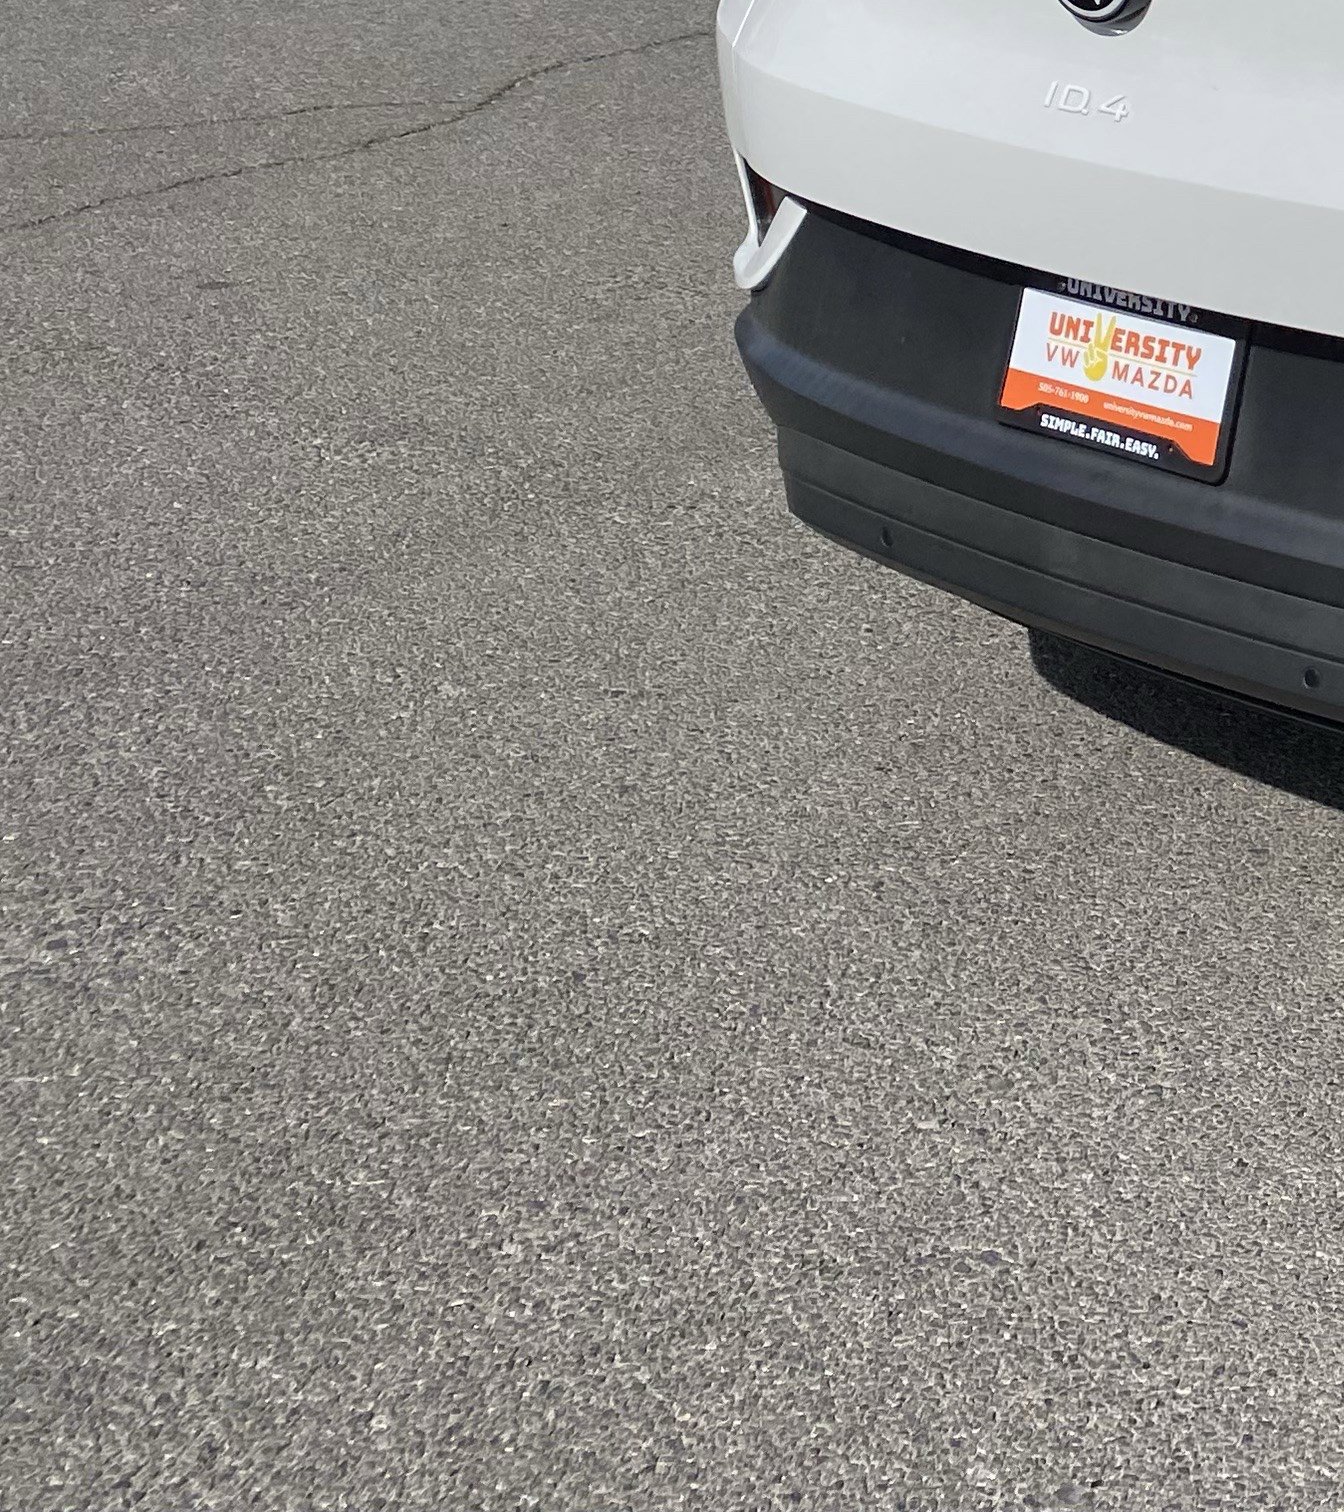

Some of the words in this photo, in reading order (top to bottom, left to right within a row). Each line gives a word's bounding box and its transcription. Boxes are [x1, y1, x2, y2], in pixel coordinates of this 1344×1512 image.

[1067, 277, 1192, 322] UNIVERSITY
[1045, 342, 1080, 369] VW
[1111, 360, 1194, 400] MAZDA
